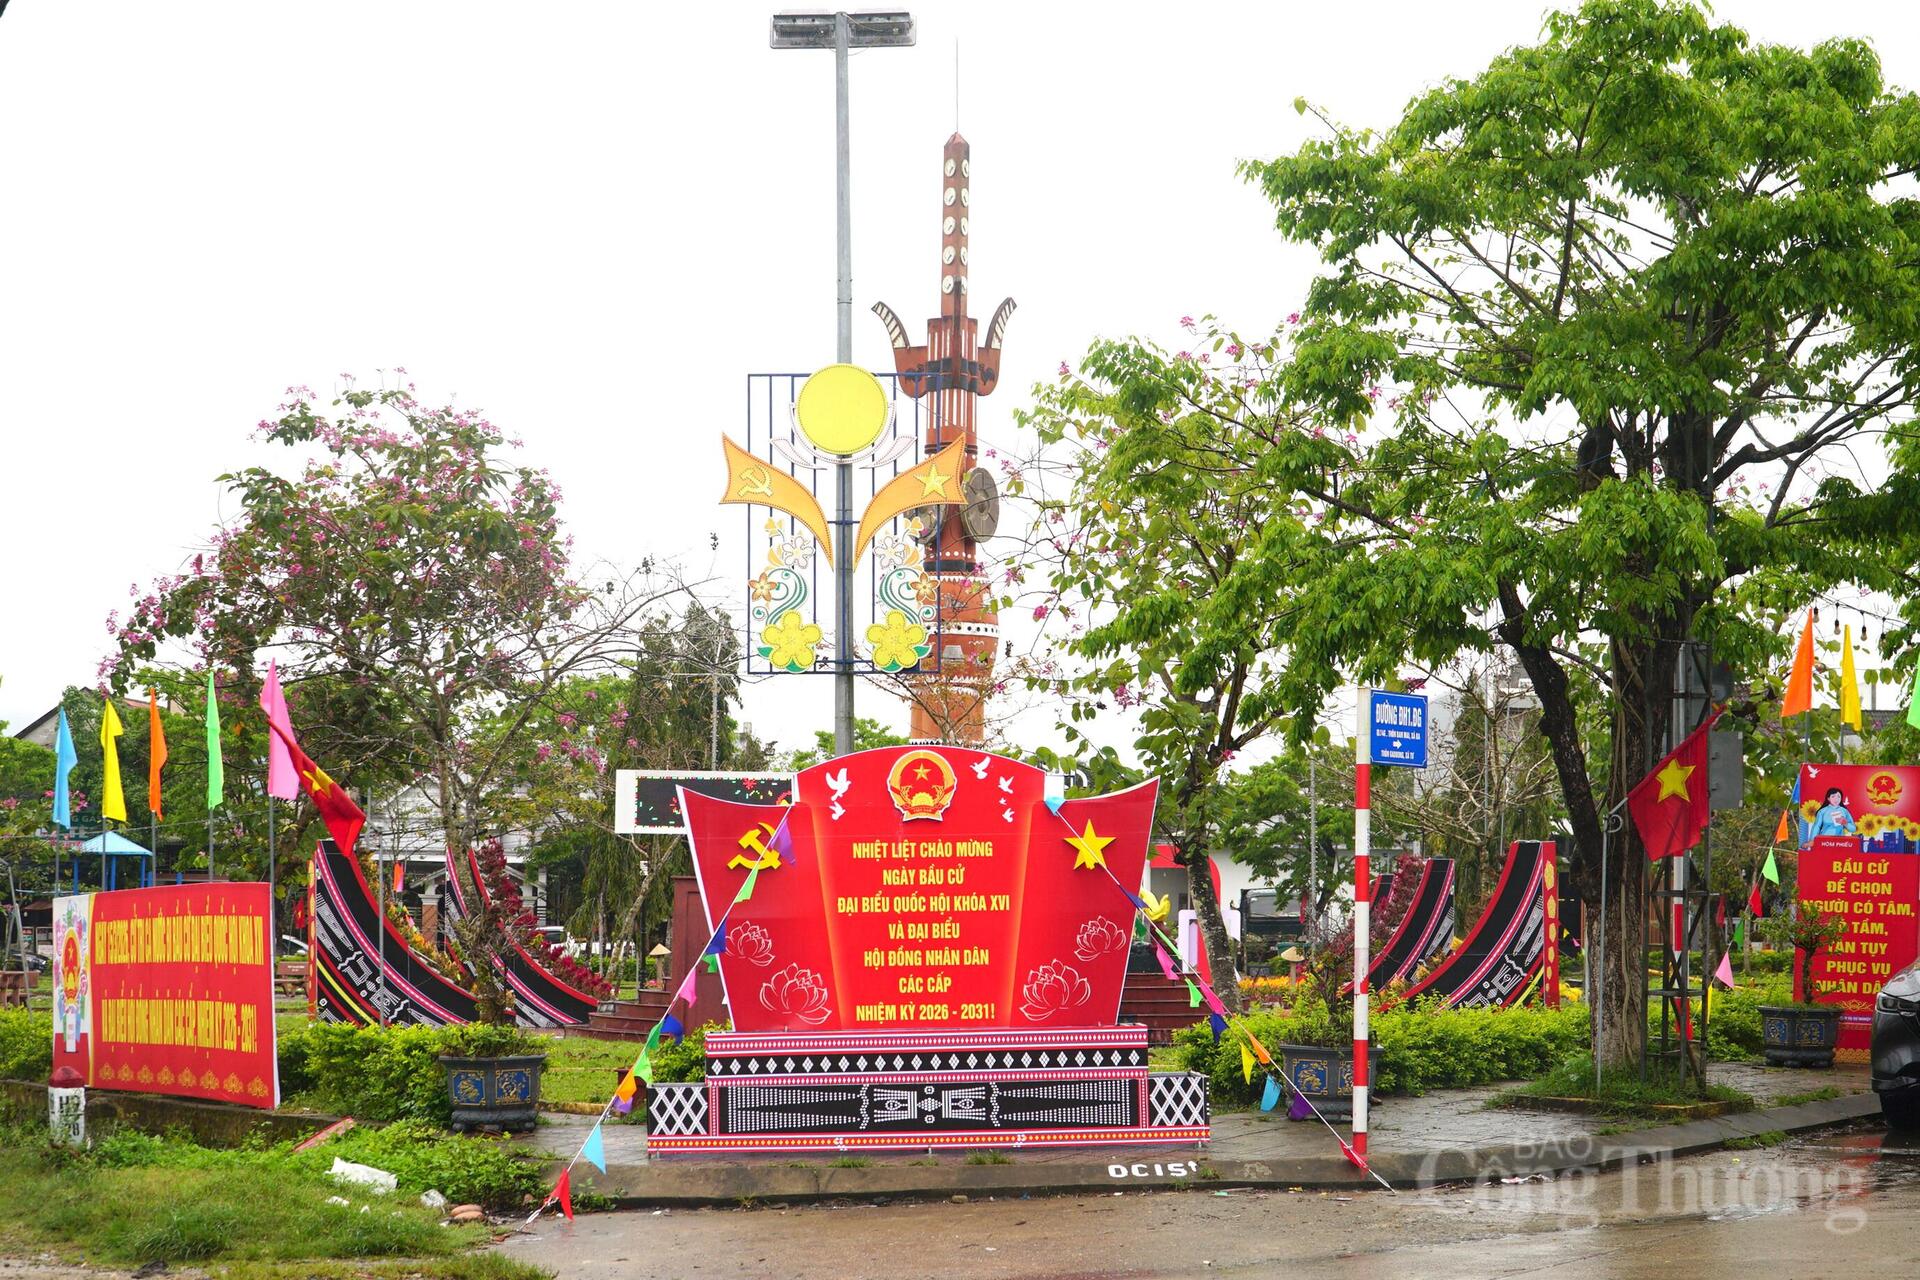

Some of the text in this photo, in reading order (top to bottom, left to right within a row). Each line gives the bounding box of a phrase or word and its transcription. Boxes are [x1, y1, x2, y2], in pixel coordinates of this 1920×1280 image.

[1376, 700, 1397, 725] ĐƯỜNG
[853, 839, 993, 861] NHIỆT LIỆT CHÀO MỪNG
[883, 864, 965, 885] NGÀY BẦU CỬ
[1868, 859, 1890, 875] CỬ
[1827, 877, 1892, 897] ĐỂ CHỌN
[838, 891, 1010, 916] ĐẠI BIỂU QUỐC HỘI KHÓA XVI
[1853, 900, 1873, 914] CÓ
[1878, 901, 1915, 917] TÂM,
[889, 917, 960, 942] VÀ ĐẠI BIỂU
[864, 945, 989, 970] HỘI ĐỒNG NHÂN DÂN
[1860, 942, 1888, 957] TỤY
[1827, 961, 1890, 977] PHỤC VỤ
[899, 971, 951, 993] CÁC CẤP
[1816, 979, 1882, 994] NHÂN DÂ
[856, 1002, 896, 1024] NHIỆM
[901, 1001, 915, 1021] KỲ
[920, 1004, 948, 1020] 2026
[961, 1003, 995, 1019] 2031!
[223, 1002, 236, 1051] 2026
